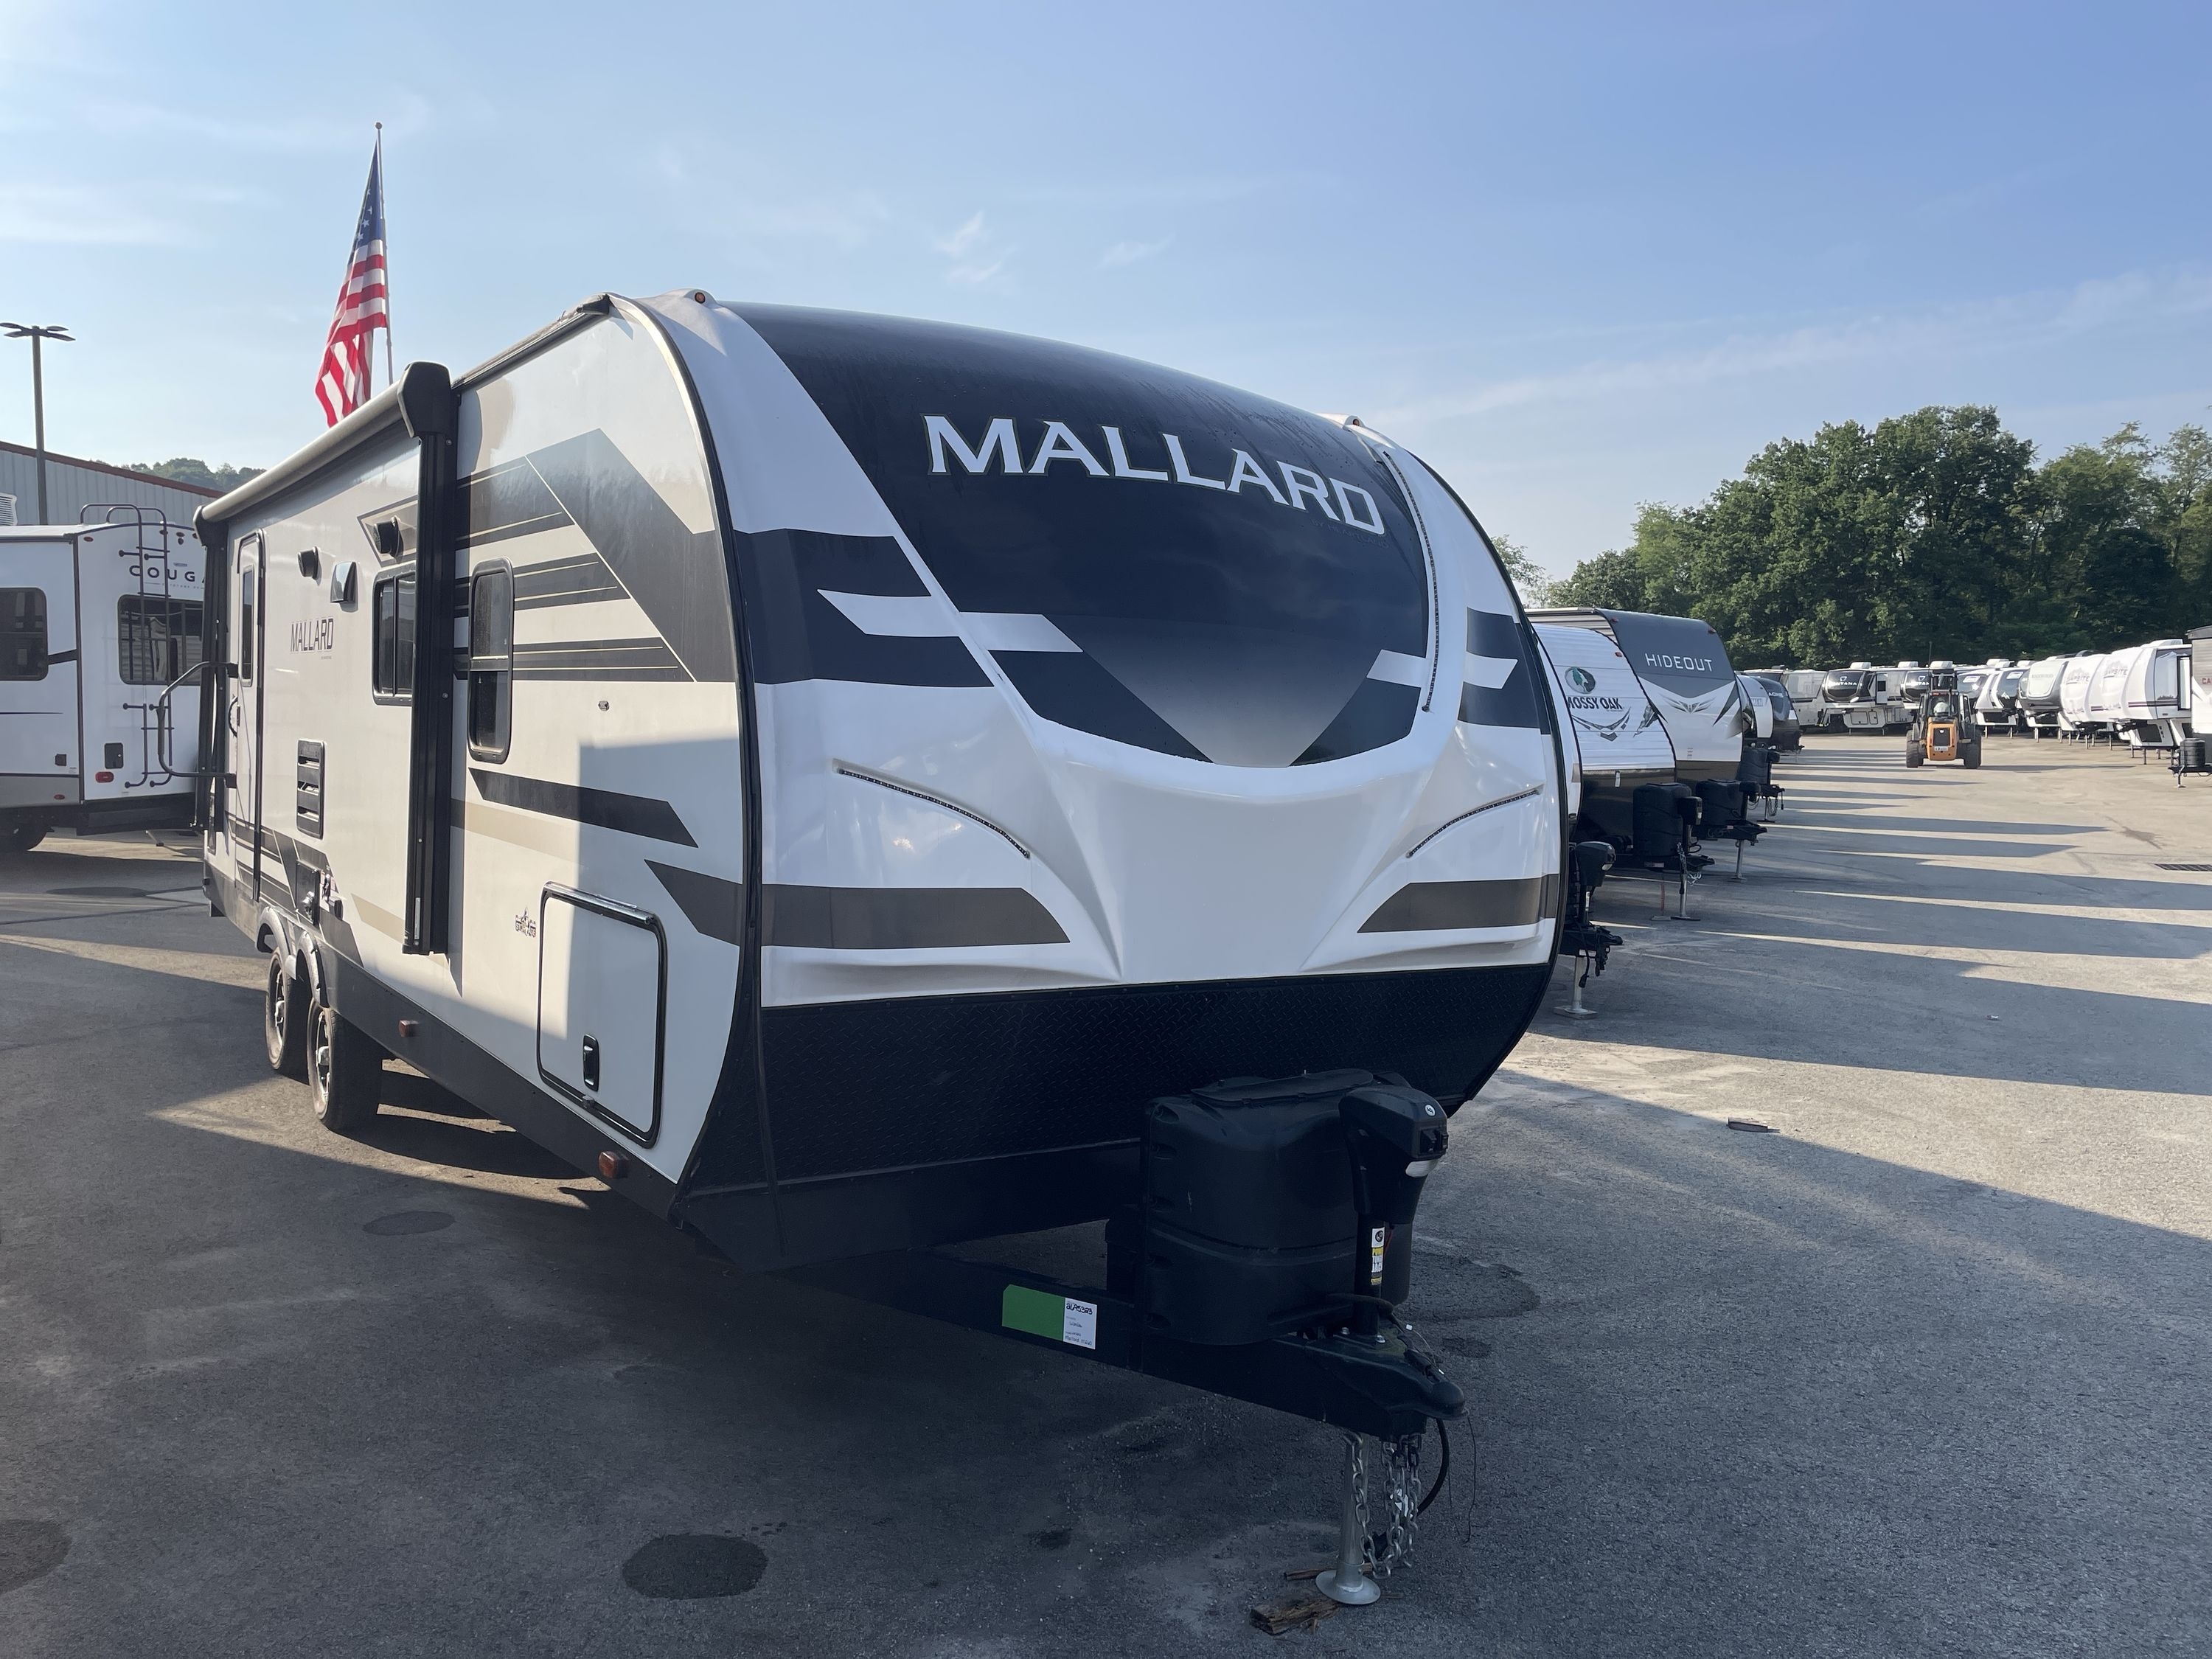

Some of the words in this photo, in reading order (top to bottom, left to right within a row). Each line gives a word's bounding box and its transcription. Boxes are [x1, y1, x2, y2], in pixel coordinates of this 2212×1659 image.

[923, 414, 1385, 535] MALLARD
[129, 565, 206, 584] COUG
[290, 618, 334, 652] MALLARD
[1645, 653, 1713, 672] HIDEOUT
[1600, 698, 1623, 709] OAK
